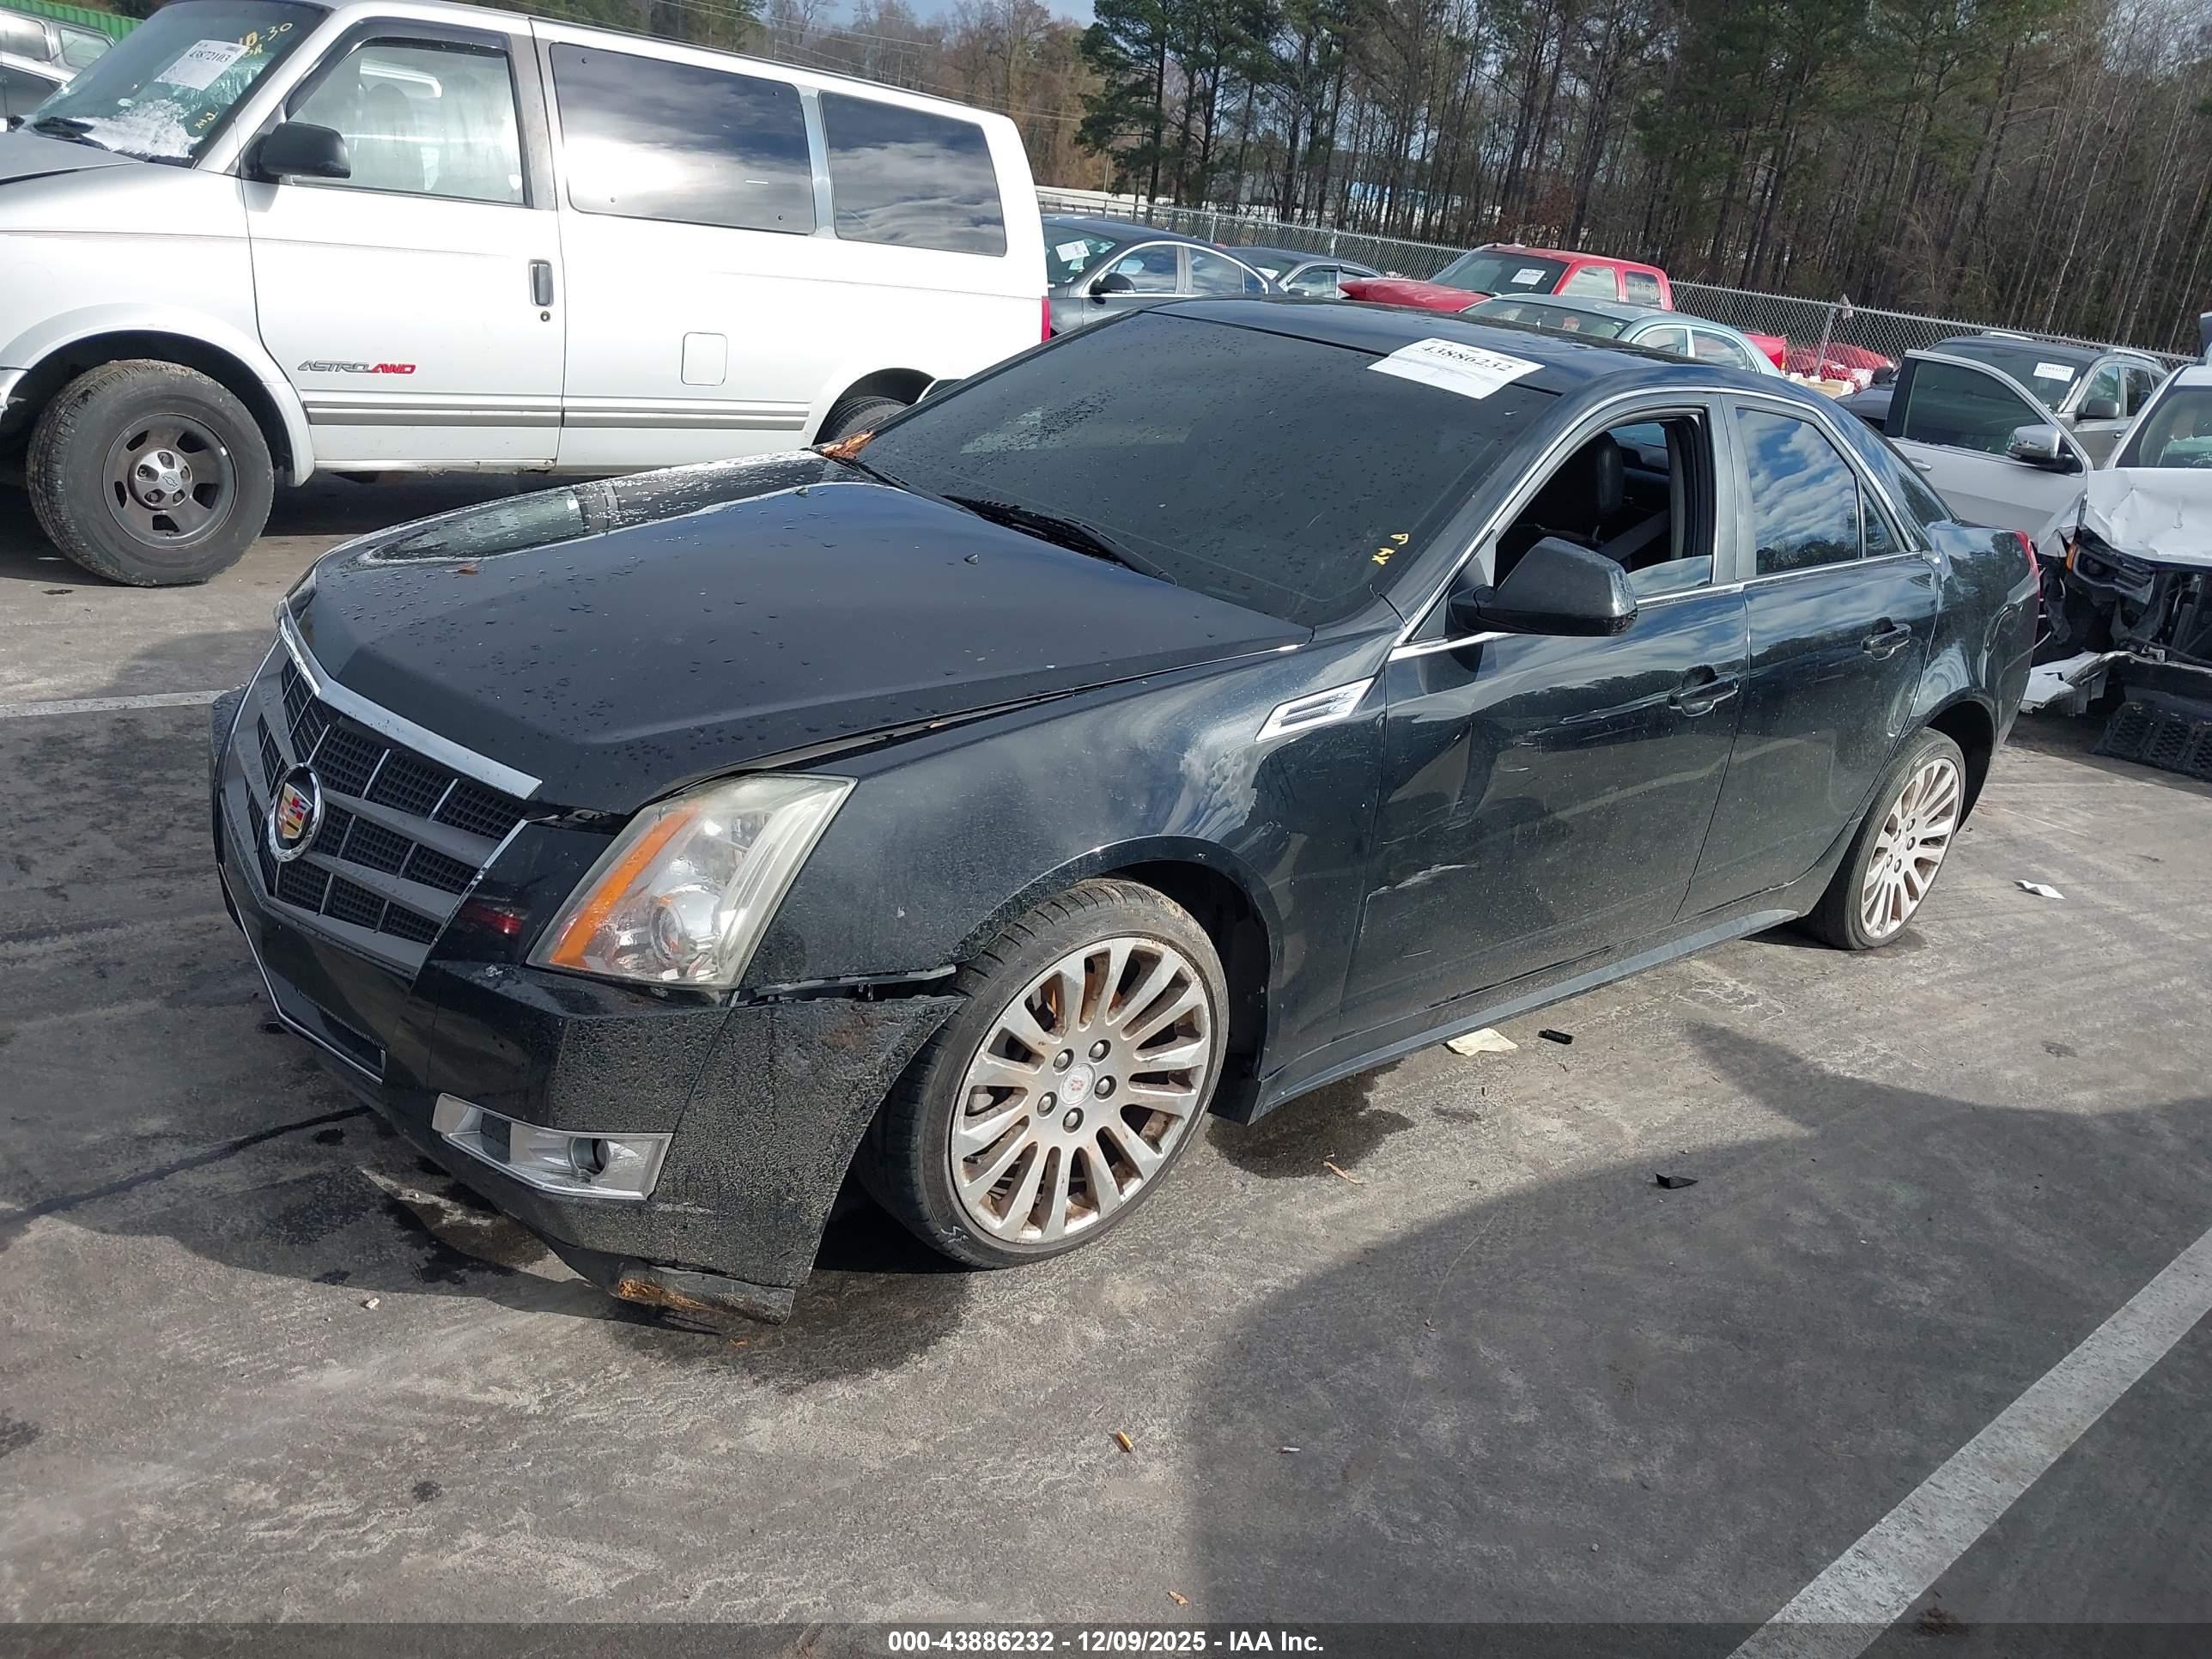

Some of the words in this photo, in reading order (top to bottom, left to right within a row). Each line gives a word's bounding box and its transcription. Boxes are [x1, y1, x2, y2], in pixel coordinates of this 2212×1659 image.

[297, 360, 371, 373] ASTRO
[371, 362, 416, 374] AWD
[1422, 345, 1513, 371] 43886232
